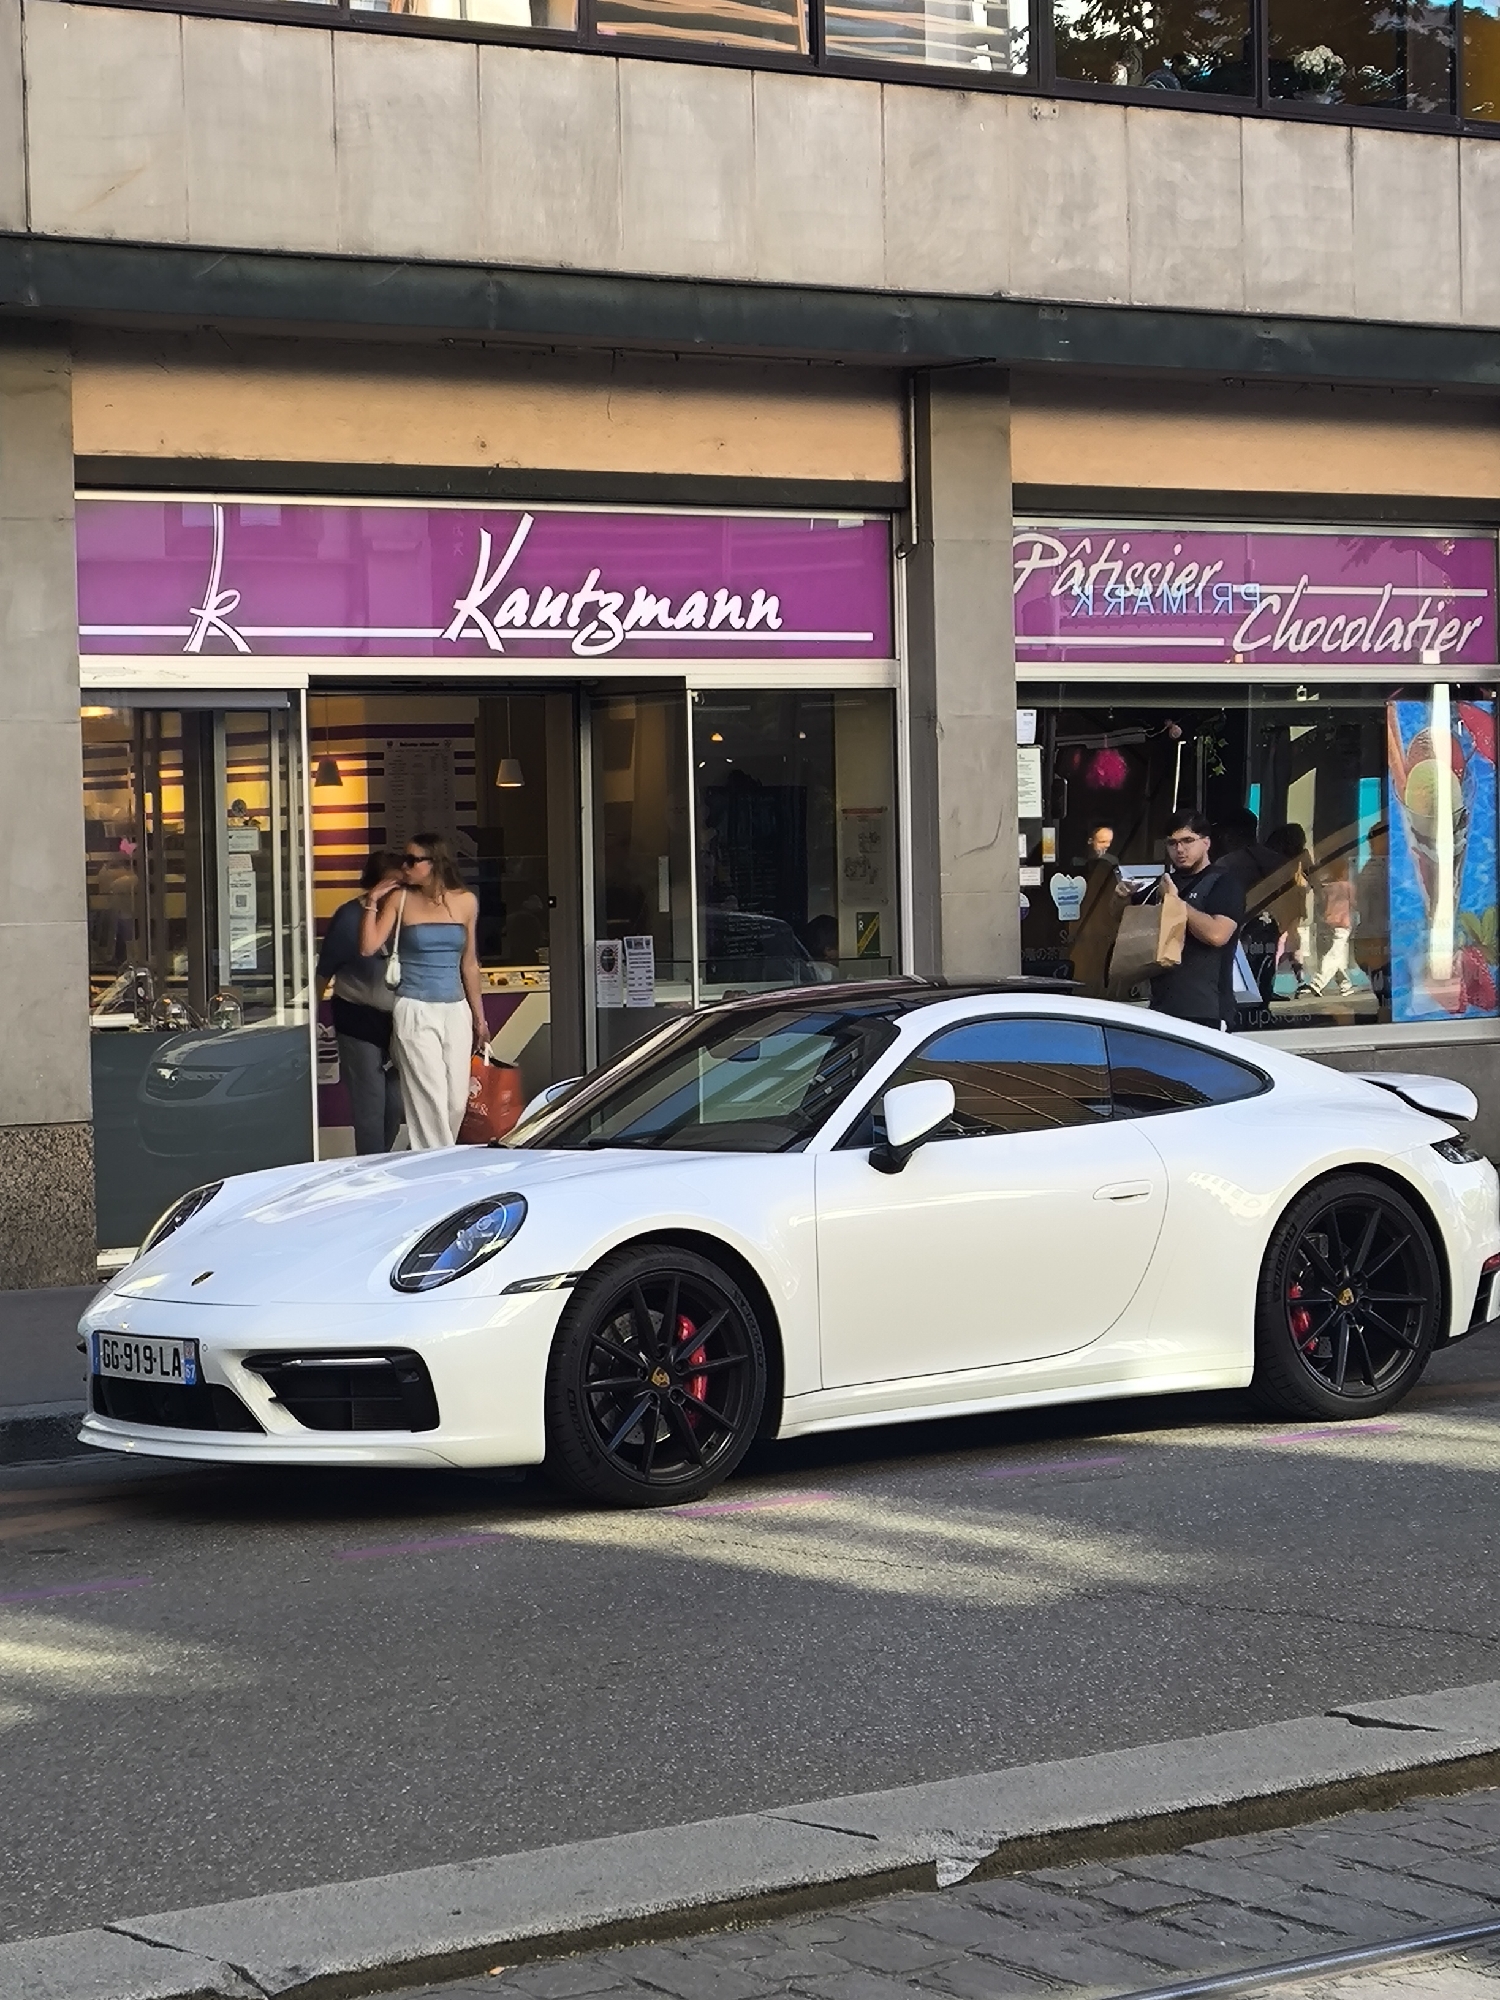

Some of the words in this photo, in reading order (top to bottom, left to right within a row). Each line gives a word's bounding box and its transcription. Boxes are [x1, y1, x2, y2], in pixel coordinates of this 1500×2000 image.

[1013, 533, 1224, 597] Pâtissier
[1232, 574, 1483, 653] Chocolatier
[103, 1339, 182, 1377] GG-919-LA
